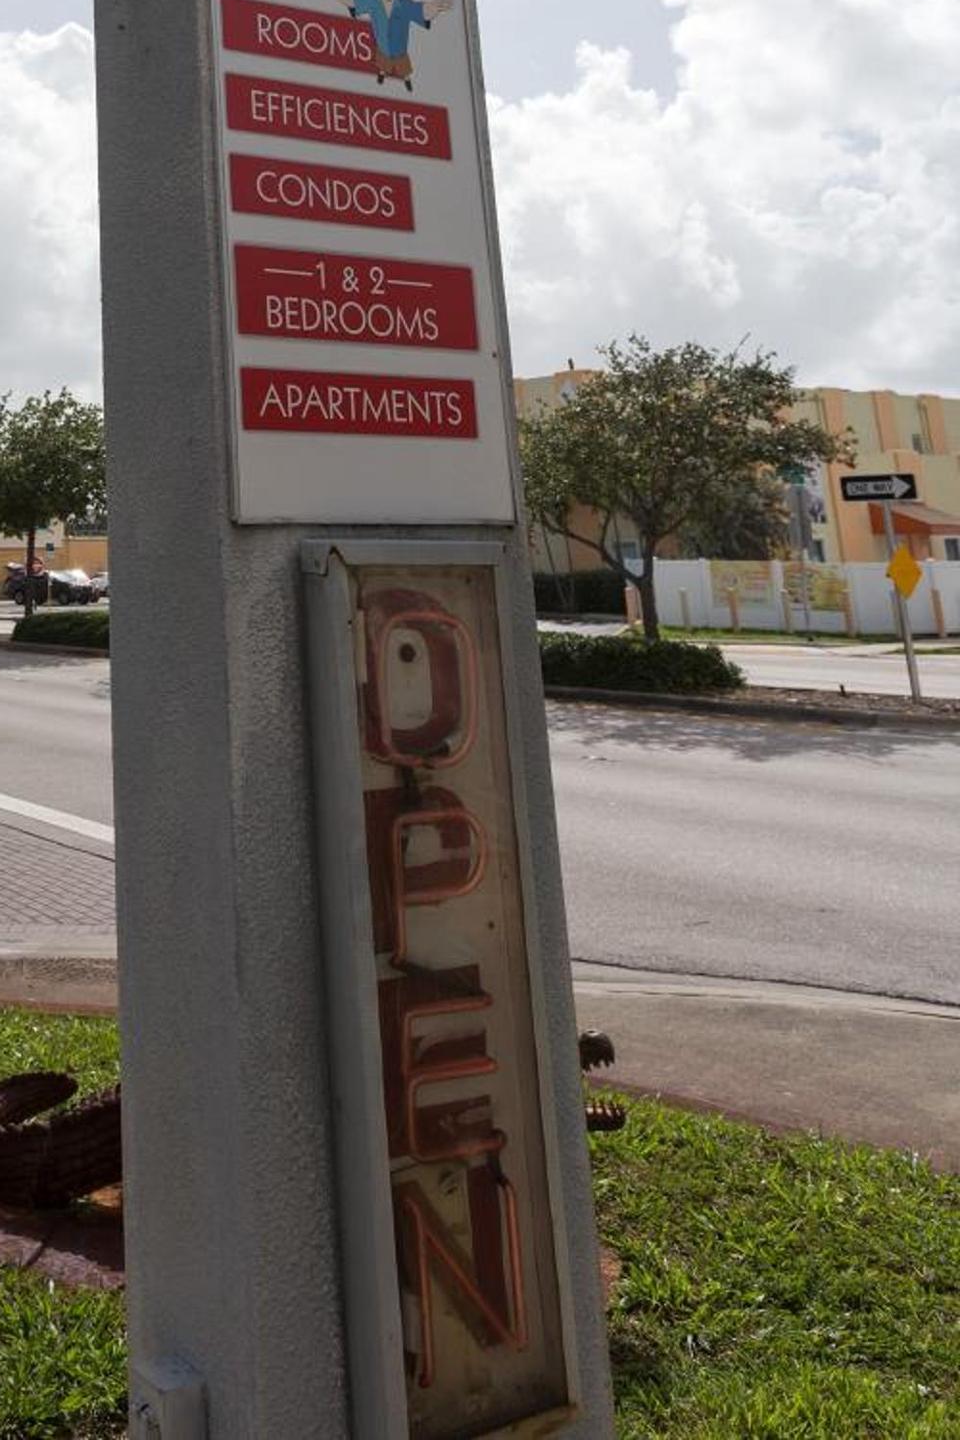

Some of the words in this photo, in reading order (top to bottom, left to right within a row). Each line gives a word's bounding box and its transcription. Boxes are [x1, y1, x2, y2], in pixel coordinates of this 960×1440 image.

[256, 13, 372, 63] ROOMS
[250, 89, 429, 146] EFFICIENCIES
[256, 170, 395, 218] CONDOS
[341, 266, 360, 294] &
[369, 266, 386, 295] 2
[265, 295, 439, 341] BEDROOMS
[260, 382, 463, 426] APARTMENTS
[362, 586, 530, 1389] OPEN
